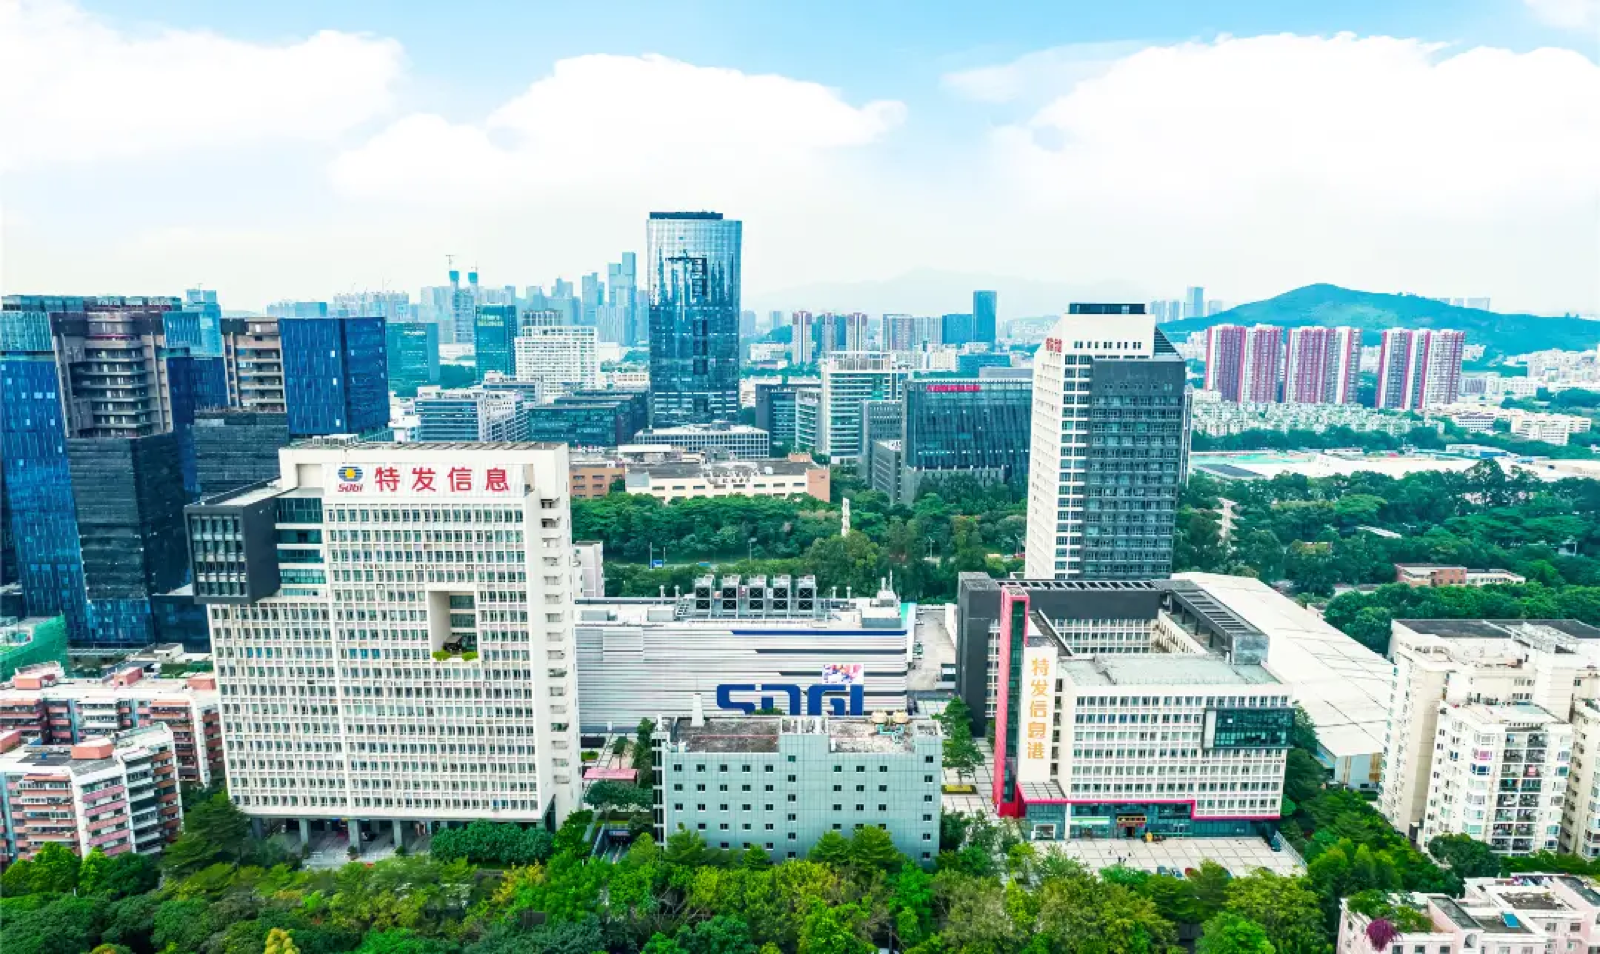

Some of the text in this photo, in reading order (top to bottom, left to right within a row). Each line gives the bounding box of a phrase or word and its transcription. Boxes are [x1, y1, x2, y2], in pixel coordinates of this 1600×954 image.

[374, 466, 509, 492] 特发信息
[1027, 657, 1050, 760] 特发信息港
